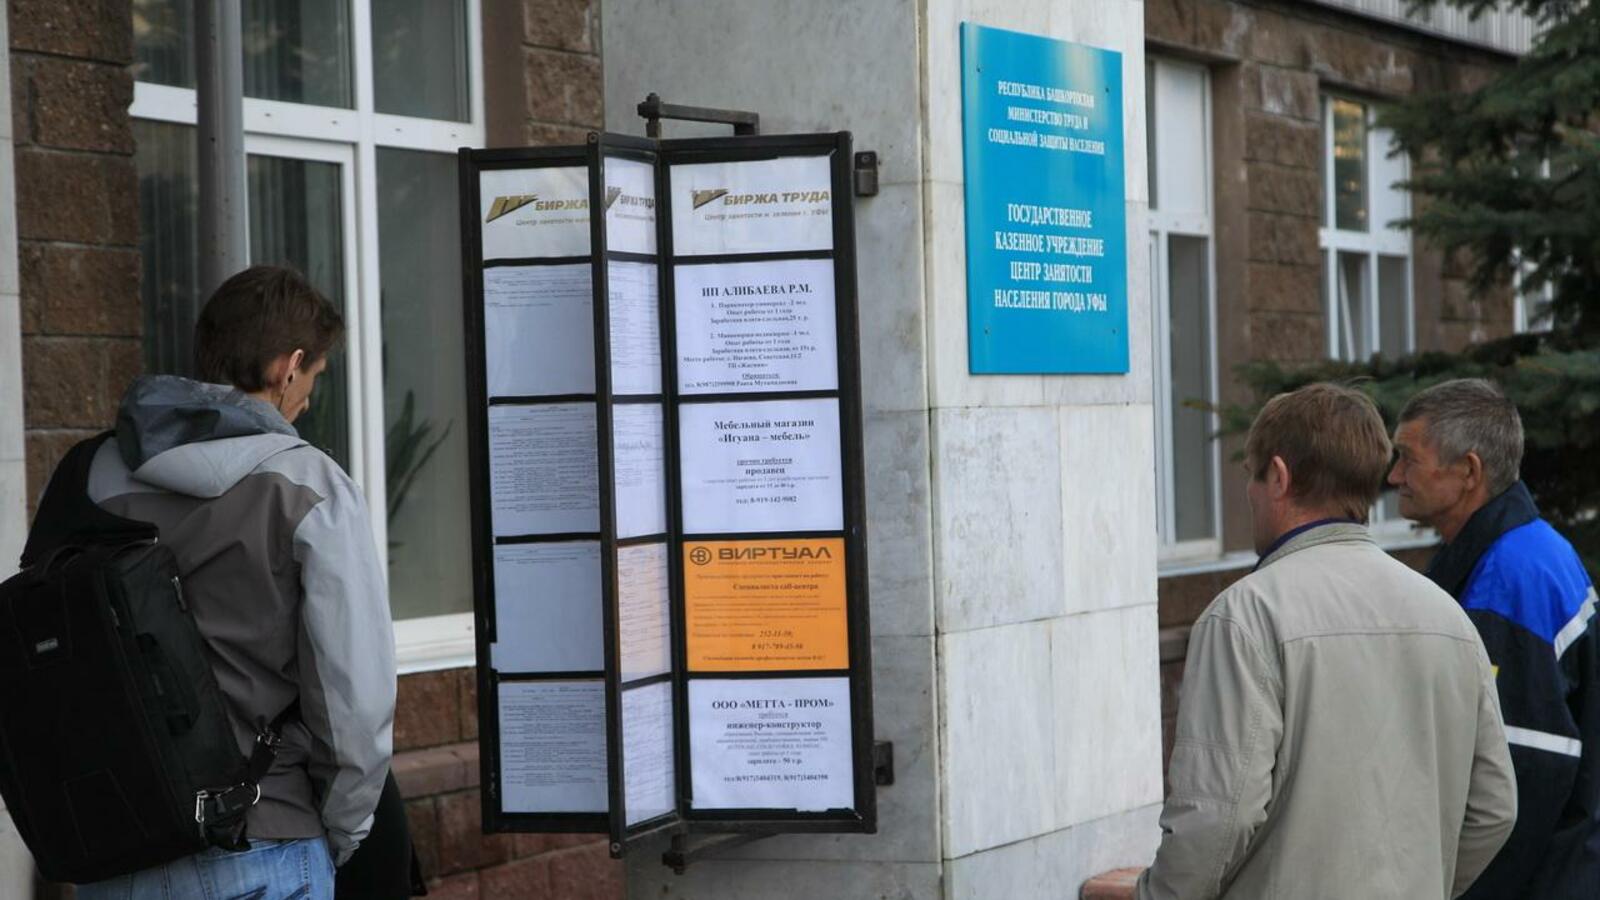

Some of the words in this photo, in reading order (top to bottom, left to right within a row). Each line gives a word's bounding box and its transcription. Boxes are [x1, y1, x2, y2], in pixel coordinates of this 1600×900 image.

[998, 80, 1046, 99] РЕСПУБЛИКА
[1007, 106, 1063, 126] МИНИСТЕРСТВО
[1063, 113, 1083, 130] ТРУДА
[988, 128, 1038, 147] СОЦИАЛЬНОЙ
[1039, 134, 1069, 150] ЗАЩИТЫ
[1069, 138, 1105, 155] НАСЕЛЕНИЯ
[535, 199, 589, 212] БИРЖА
[723, 192, 779, 207] БИРЖА
[781, 190, 830, 204] ТРУДА
[1008, 203, 1092, 229] ГОСУДАРСТВЕННОЕ
[995, 231, 1044, 253] КАЗЕННОЕ
[1046, 235, 1104, 258] УЧРЕЖДЕНИЕ
[1010, 261, 1042, 282] ЦЕНТР
[1043, 264, 1092, 284] ЗАНЯТОСТИ
[702, 286, 719, 297] ИП
[722, 284, 786, 297] АЛИБАЕВА
[788, 283, 813, 295] Р.М.
[994, 289, 1050, 310] НАСЕЛЕНИЯ
[1052, 292, 1086, 313] ГОРОДА
[1086, 293, 1107, 312] УФЫ
[714, 420, 771, 431] Мебельный
[774, 419, 815, 429] магазин
[718, 433, 760, 444] «Игуана
[719, 546, 832, 560] ВИРТУАЛ
[712, 699, 738, 710] ООО
